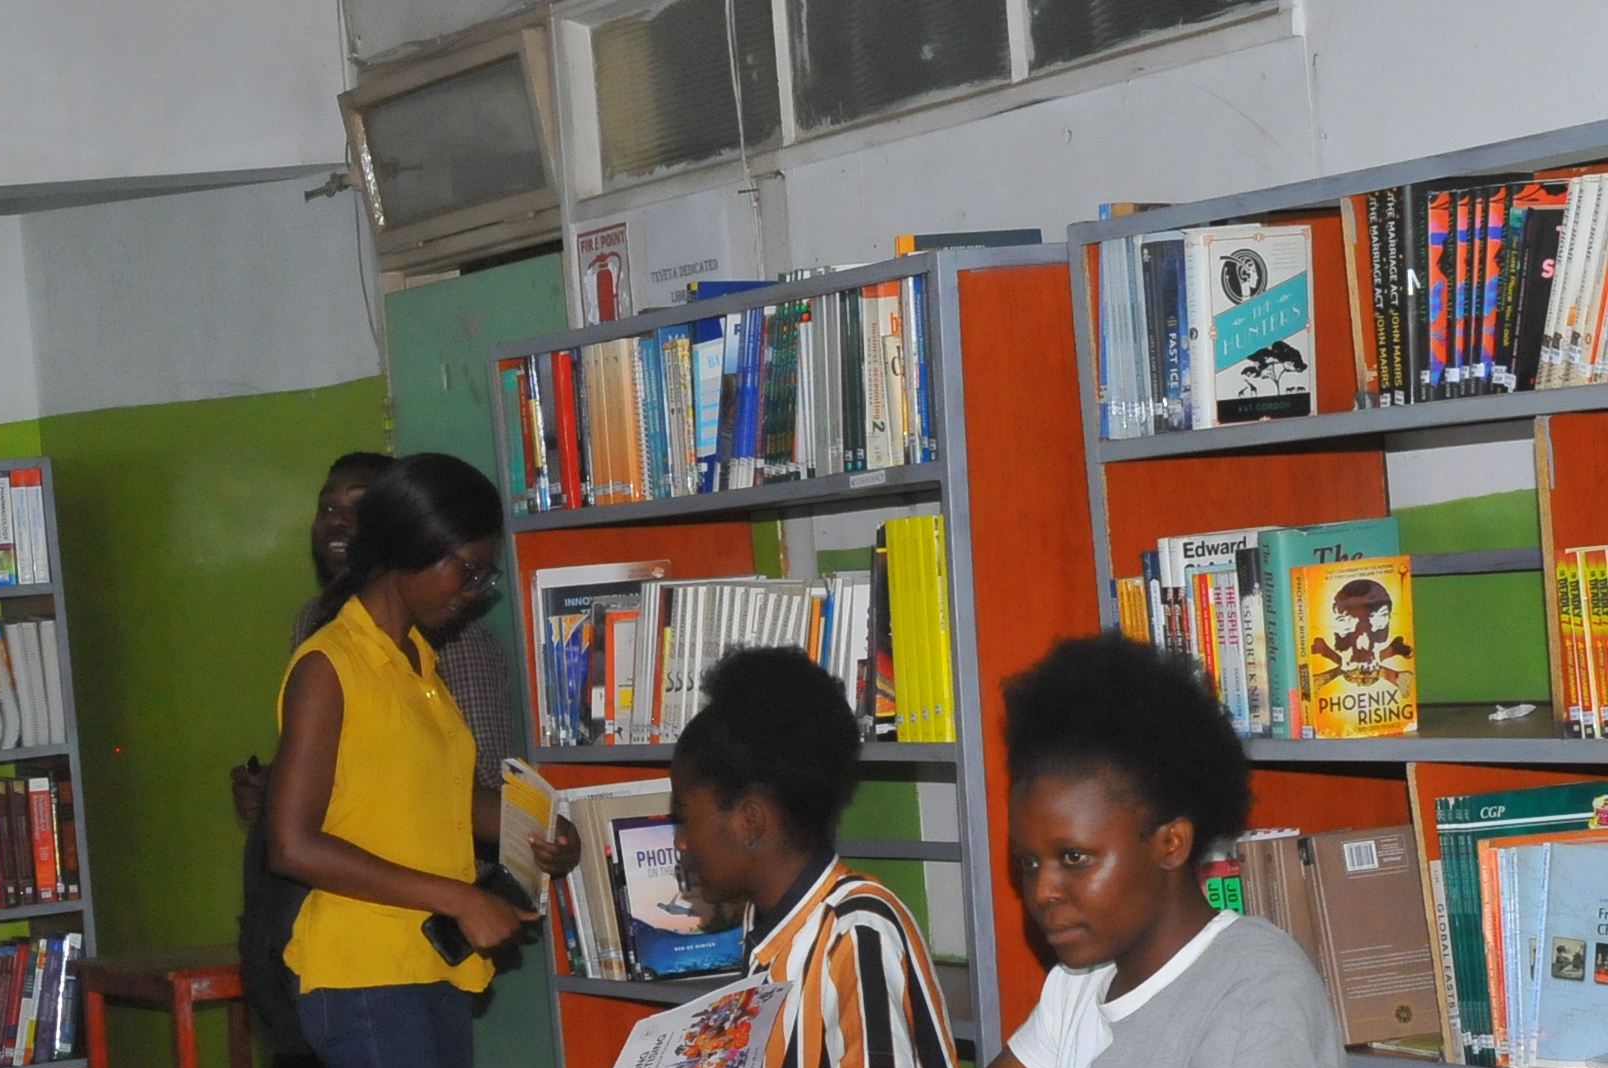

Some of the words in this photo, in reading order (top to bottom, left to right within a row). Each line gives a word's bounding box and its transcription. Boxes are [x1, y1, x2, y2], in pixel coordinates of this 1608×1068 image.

[1369, 201, 1378, 223] THE
[1386, 197, 1395, 219] THE
[581, 238, 599, 253] FIRE
[601, 231, 624, 248] POINT
[1387, 222, 1397, 281] MARRIAGE
[1566, 230, 1578, 263] HOME
[1585, 228, 1596, 262] HOME
[1370, 226, 1382, 285] MARRIAGE
[1509, 250, 1518, 273] Last
[651, 269, 677, 283] TEVETA
[679, 259, 718, 276] DEDICATED
[1375, 288, 1383, 309] ACT
[1390, 284, 1399, 306] ACT
[1507, 276, 1517, 303] Place
[1252, 301, 1271, 319] THE
[1505, 305, 1513, 321] You
[1223, 305, 1301, 355] HUNTERS
[1376, 314, 1386, 345] JOHN
[1391, 311, 1401, 343] JOHN
[1503, 323, 1511, 347] Look
[1169, 333, 1178, 364] FAST
[1170, 366, 1179, 388] ICE
[1379, 348, 1389, 388] MARRS
[1393, 346, 1403, 386] MARRS
[873, 367, 881, 420] accounting
[872, 421, 886, 433] 2
[0, 486, 8, 540] PHARMACOLOGY
[1183, 537, 1247, 559] Edward
[1263, 543, 1271, 565] The
[1314, 543, 1364, 564] The
[1214, 586, 1223, 607] THE
[1225, 585, 1236, 608] THE
[1264, 572, 1276, 613] Blind
[1296, 576, 1304, 622] PHOENIX
[1559, 578, 1571, 616] DEADLY
[1570, 580, 1583, 617] DEADLY
[1590, 578, 1601, 616] DEADLY
[1215, 611, 1225, 646] SPLIT
[1228, 612, 1239, 645] SPLIT
[1562, 618, 1572, 626] 7
[1574, 619, 1583, 627] 7
[1592, 618, 1602, 626] 7
[1243, 611, 1255, 668] SHORT
[1267, 621, 1278, 663] Light
[1318, 689, 1399, 714] PHOENIX
[1358, 703, 1414, 725] RISING
[1480, 806, 1505, 819] CGP
[647, 868, 659, 878] ON
[660, 867, 673, 877] THE
[1436, 903, 1450, 960] GLOBAL
[1444, 965, 1456, 1009] EASTS
